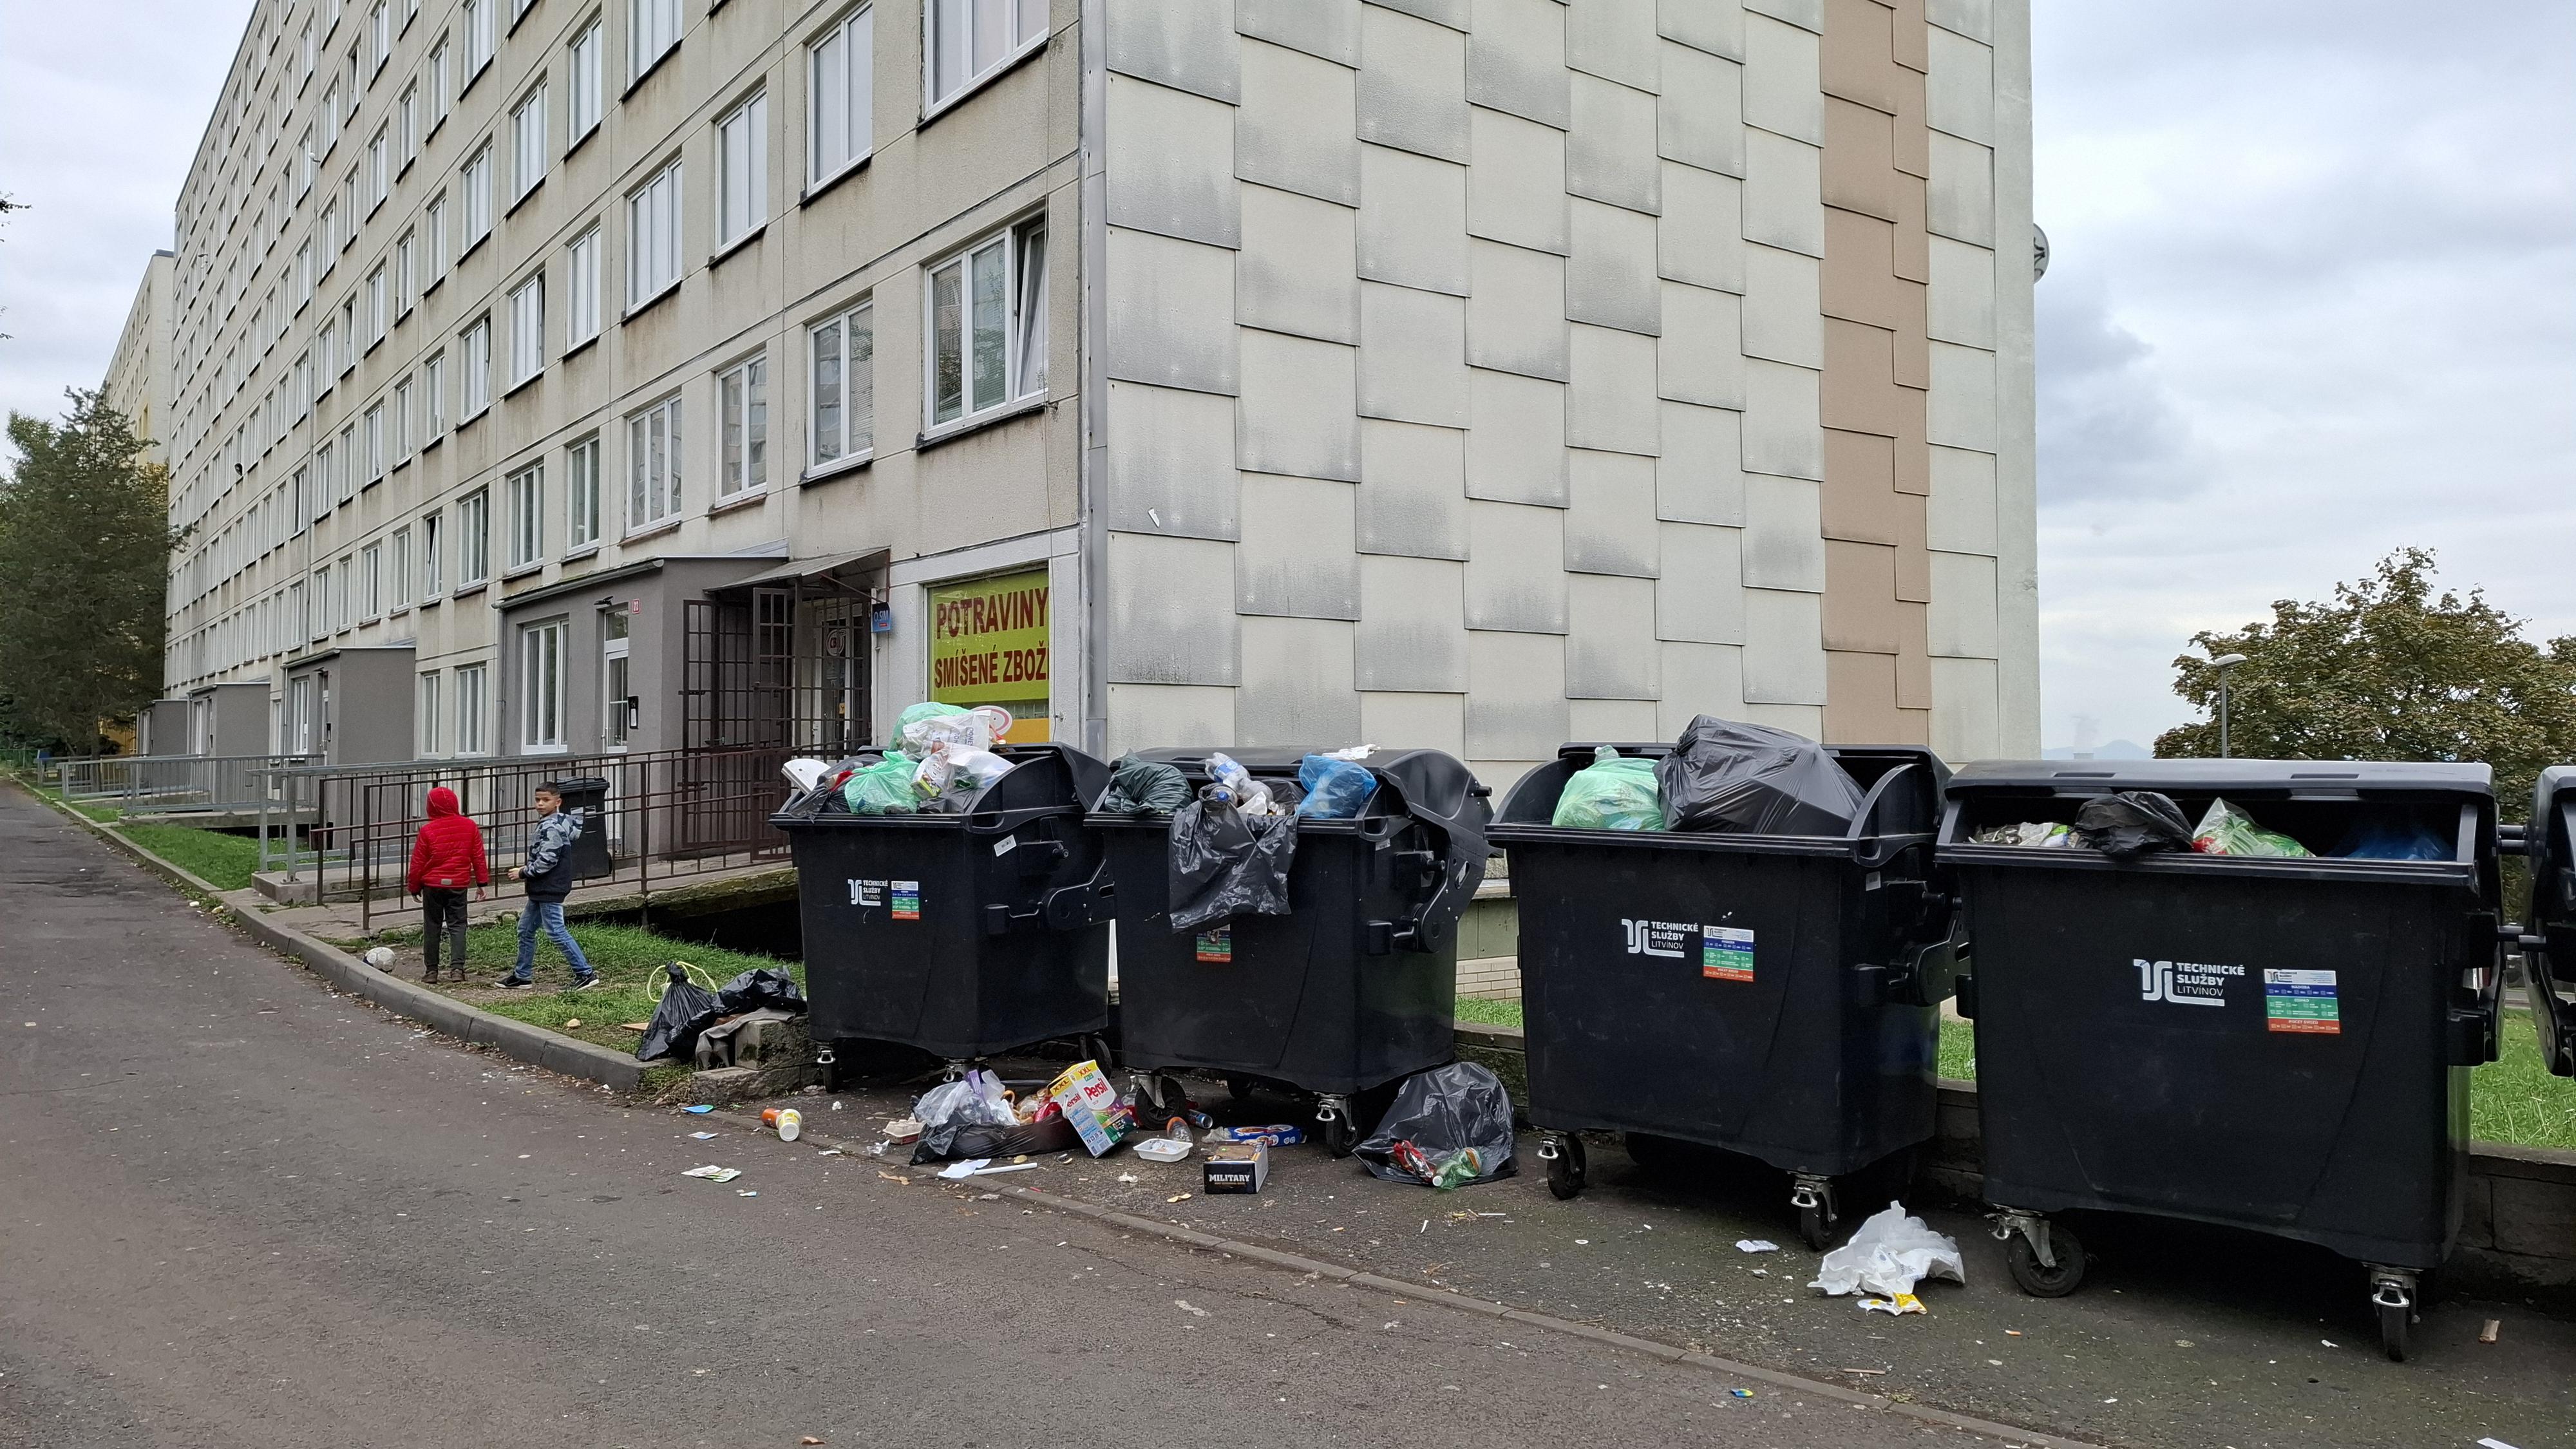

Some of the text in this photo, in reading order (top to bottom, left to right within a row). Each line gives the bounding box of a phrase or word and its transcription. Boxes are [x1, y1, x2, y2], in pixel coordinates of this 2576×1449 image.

[936, 587, 1049, 639] POTRAVINY
[934, 644, 998, 689] SMÍŠENÉ
[1651, 921, 1698, 932] TECHNICKÉ
[1651, 931, 1685, 941] SLUŽBY
[1651, 940, 1683, 949] LITVÍNOV
[2176, 962, 2245, 976] TECHNICKÉ
[2177, 974, 2224, 986] SLUŽBY
[2177, 985, 2224, 996] LITVÍNOV
[1078, 1066, 1092, 1075] XXL
[1052, 1079, 1070, 1093] XXL
[1083, 1077, 1108, 1101] Persil
[1067, 1093, 1082, 1108] ersil
